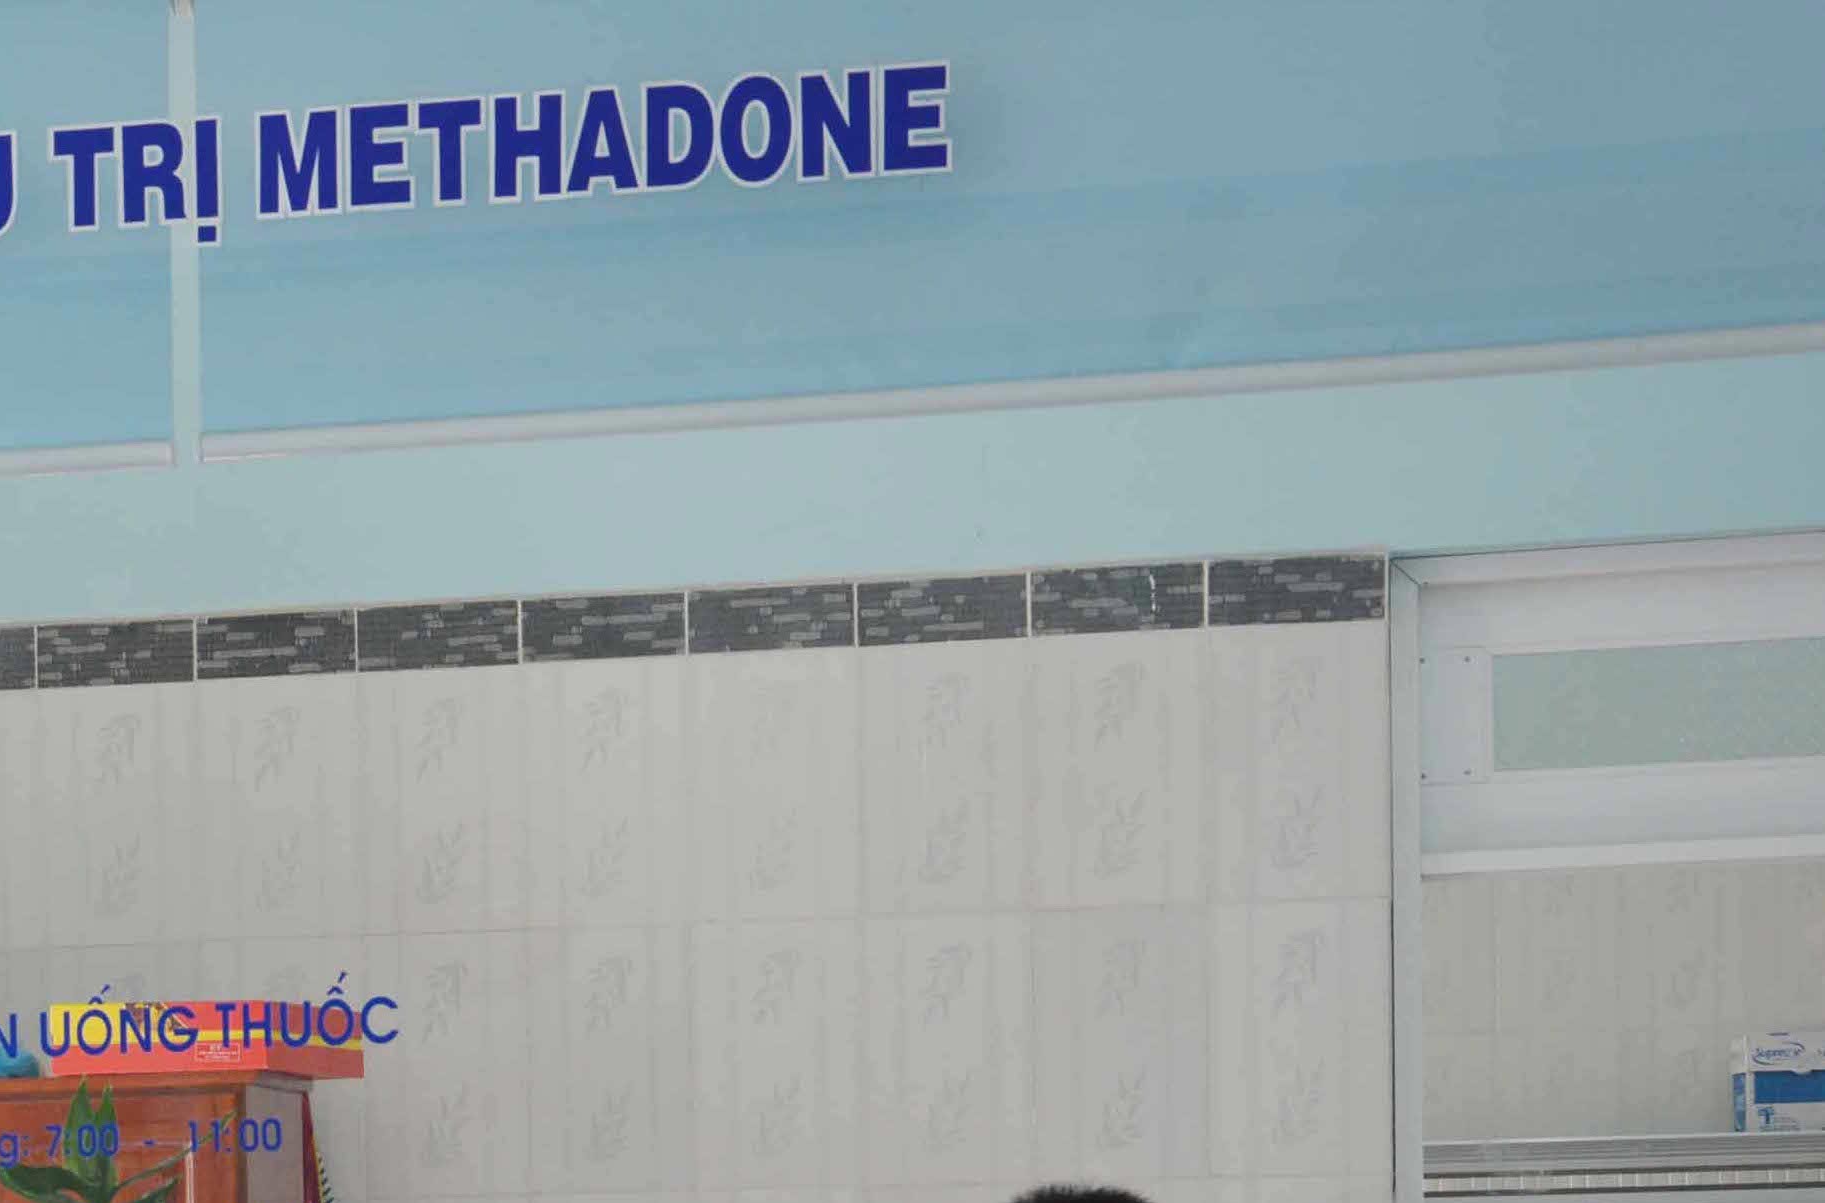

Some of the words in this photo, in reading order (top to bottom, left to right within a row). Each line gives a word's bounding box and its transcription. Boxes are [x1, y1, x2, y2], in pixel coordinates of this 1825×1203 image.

[51, 118, 219, 243] TRỊ
[257, 64, 949, 215] METHADONE
[39, 984, 198, 1057] UỐNG
[215, 971, 398, 1049] THUỐC
[45, 1123, 119, 1158] 7:00
[188, 1118, 281, 1152] 11:00
